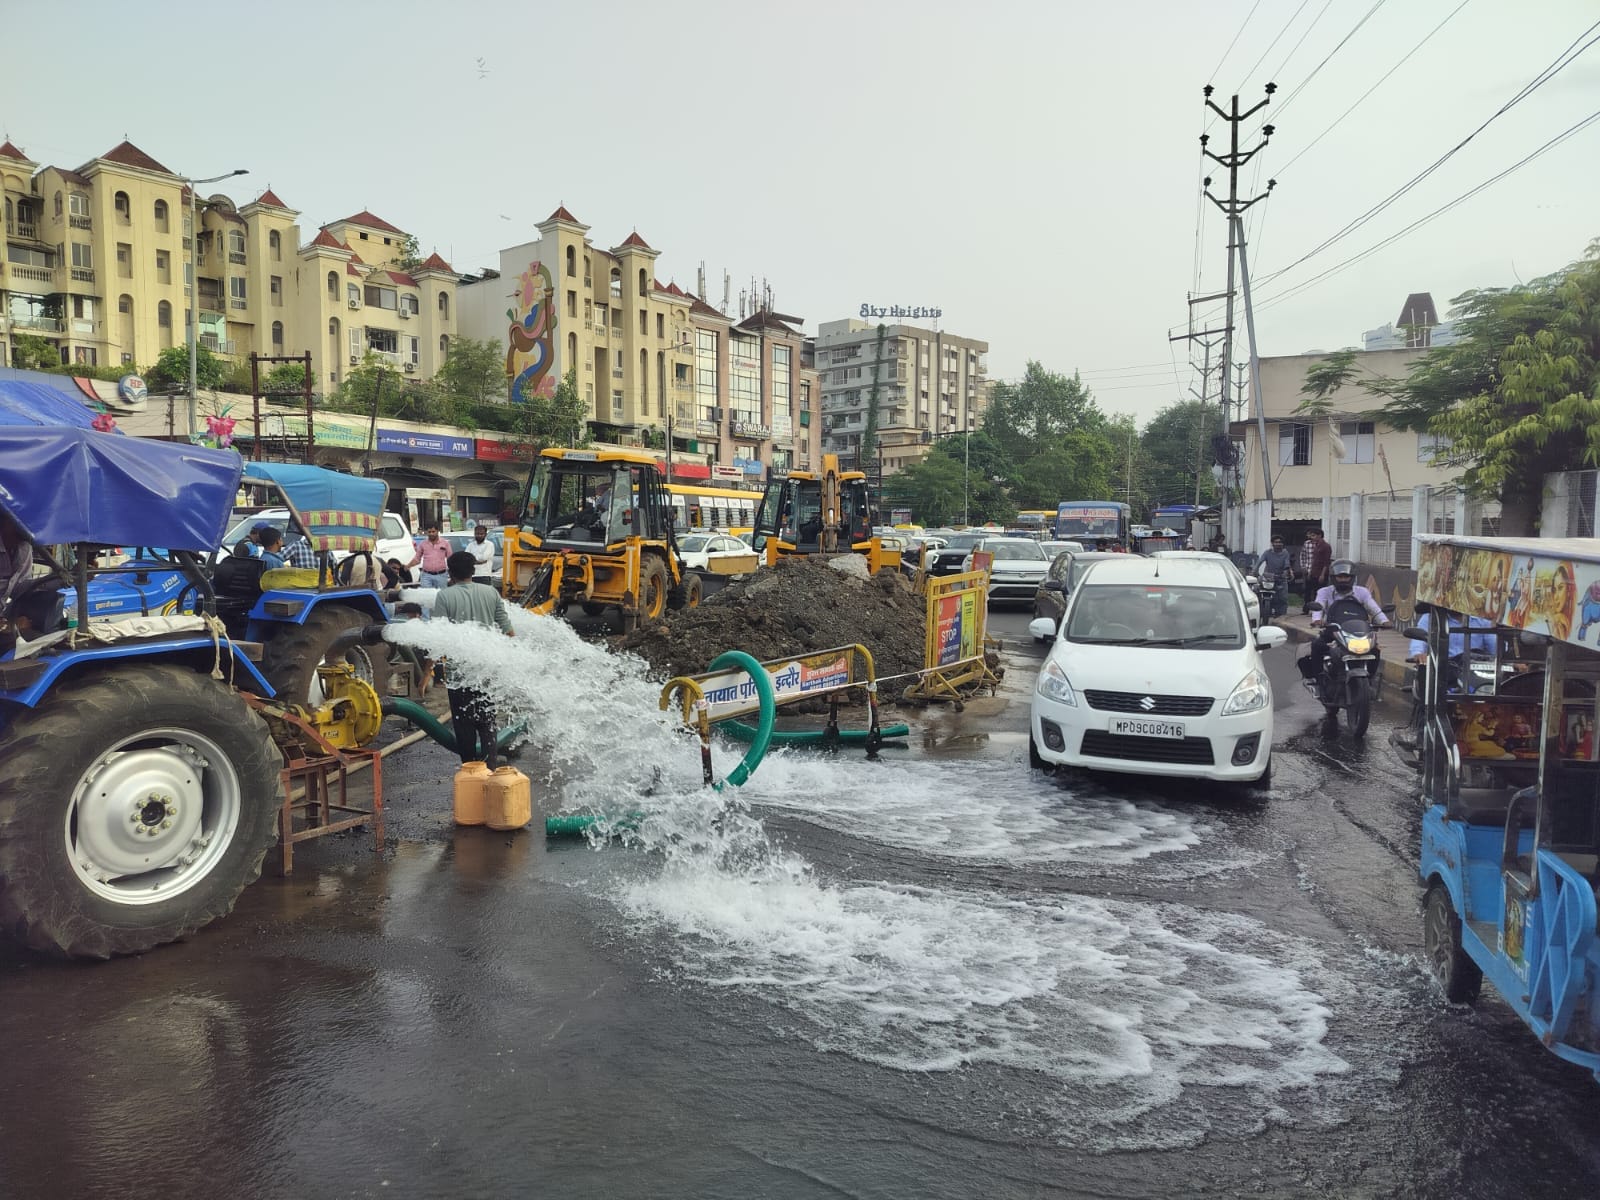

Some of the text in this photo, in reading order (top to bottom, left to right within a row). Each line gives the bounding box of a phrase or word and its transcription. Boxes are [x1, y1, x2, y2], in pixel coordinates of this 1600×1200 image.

[859, 303, 942, 318] Sky Heights
[742, 423, 771, 434] SWARAJ
[452, 442, 468, 452] ATM
[941, 629, 957, 643] STOP
